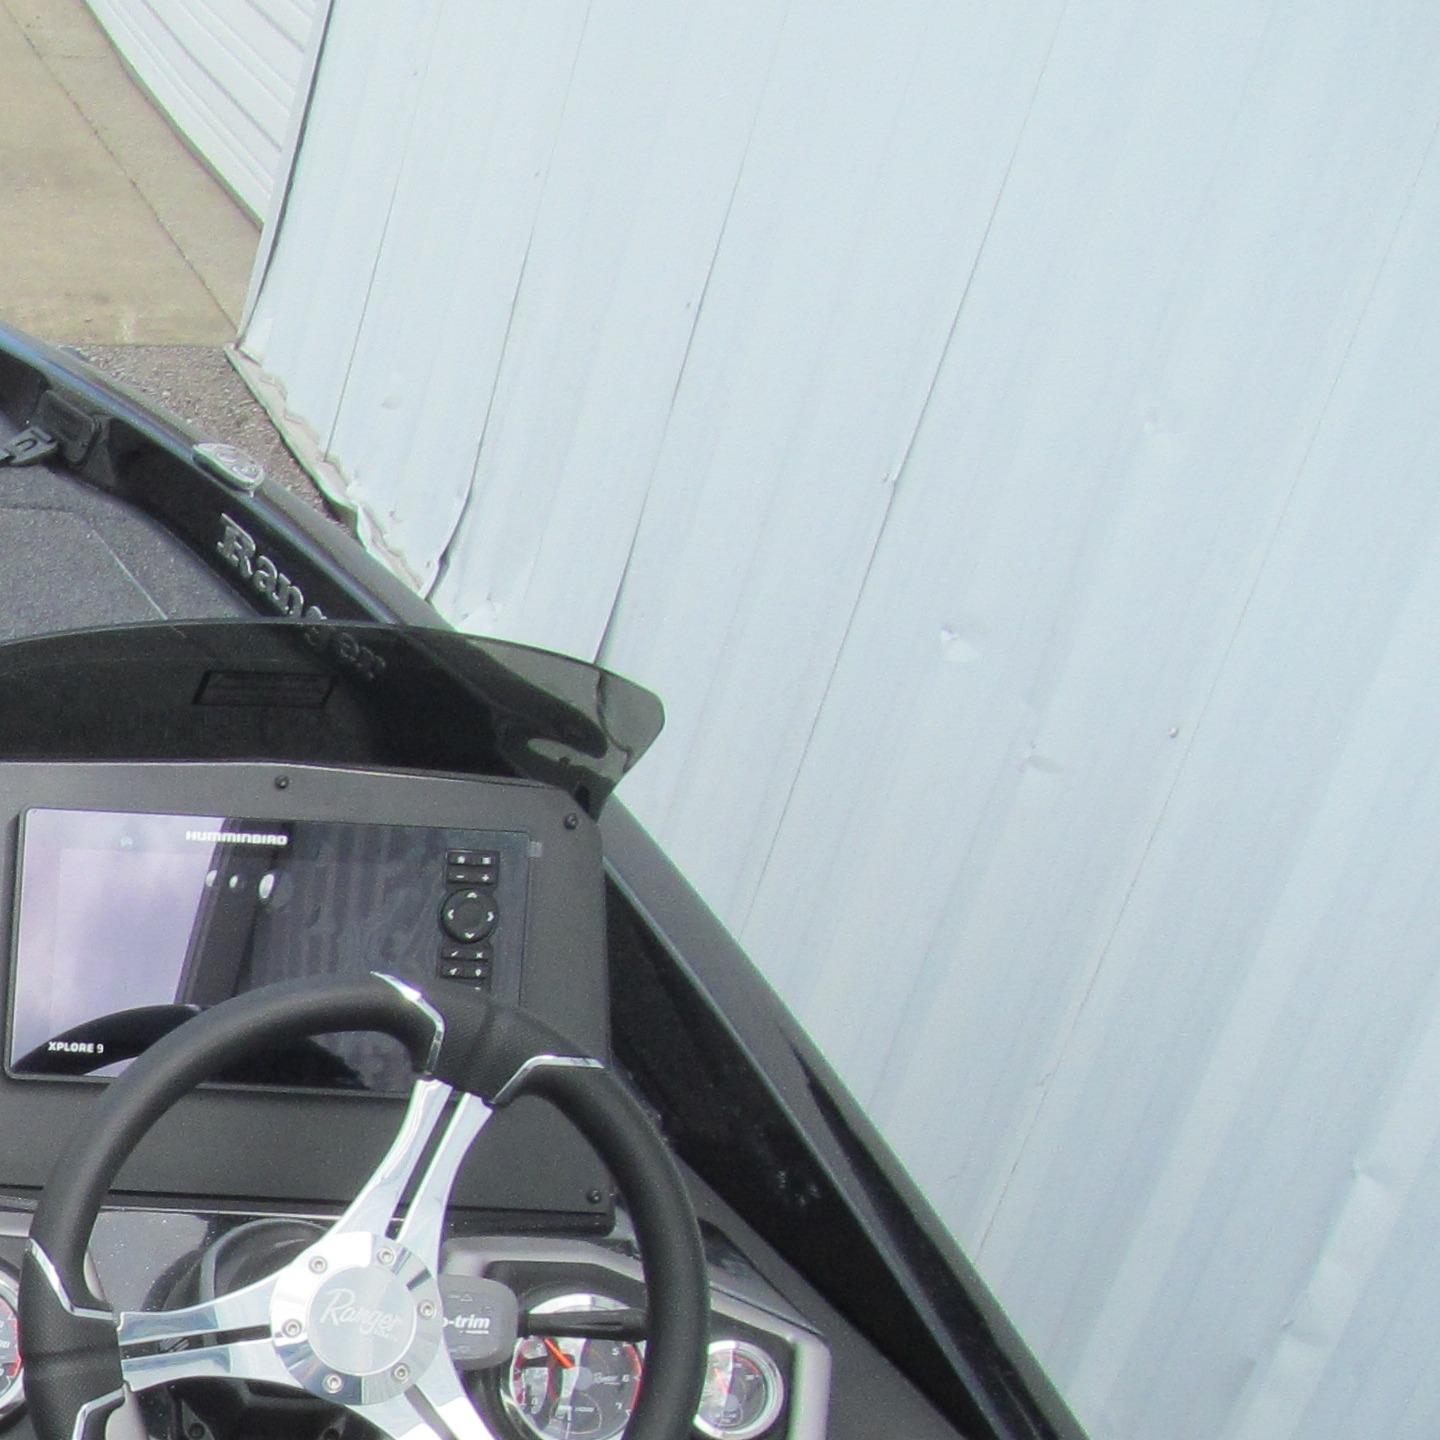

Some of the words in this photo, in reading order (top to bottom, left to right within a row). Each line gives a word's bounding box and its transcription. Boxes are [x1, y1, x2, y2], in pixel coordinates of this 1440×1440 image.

[185, 830, 288, 846] HUMMINBIRD
[48, 1041, 95, 1053] XPLORE
[97, 1043, 104, 1054] 9
